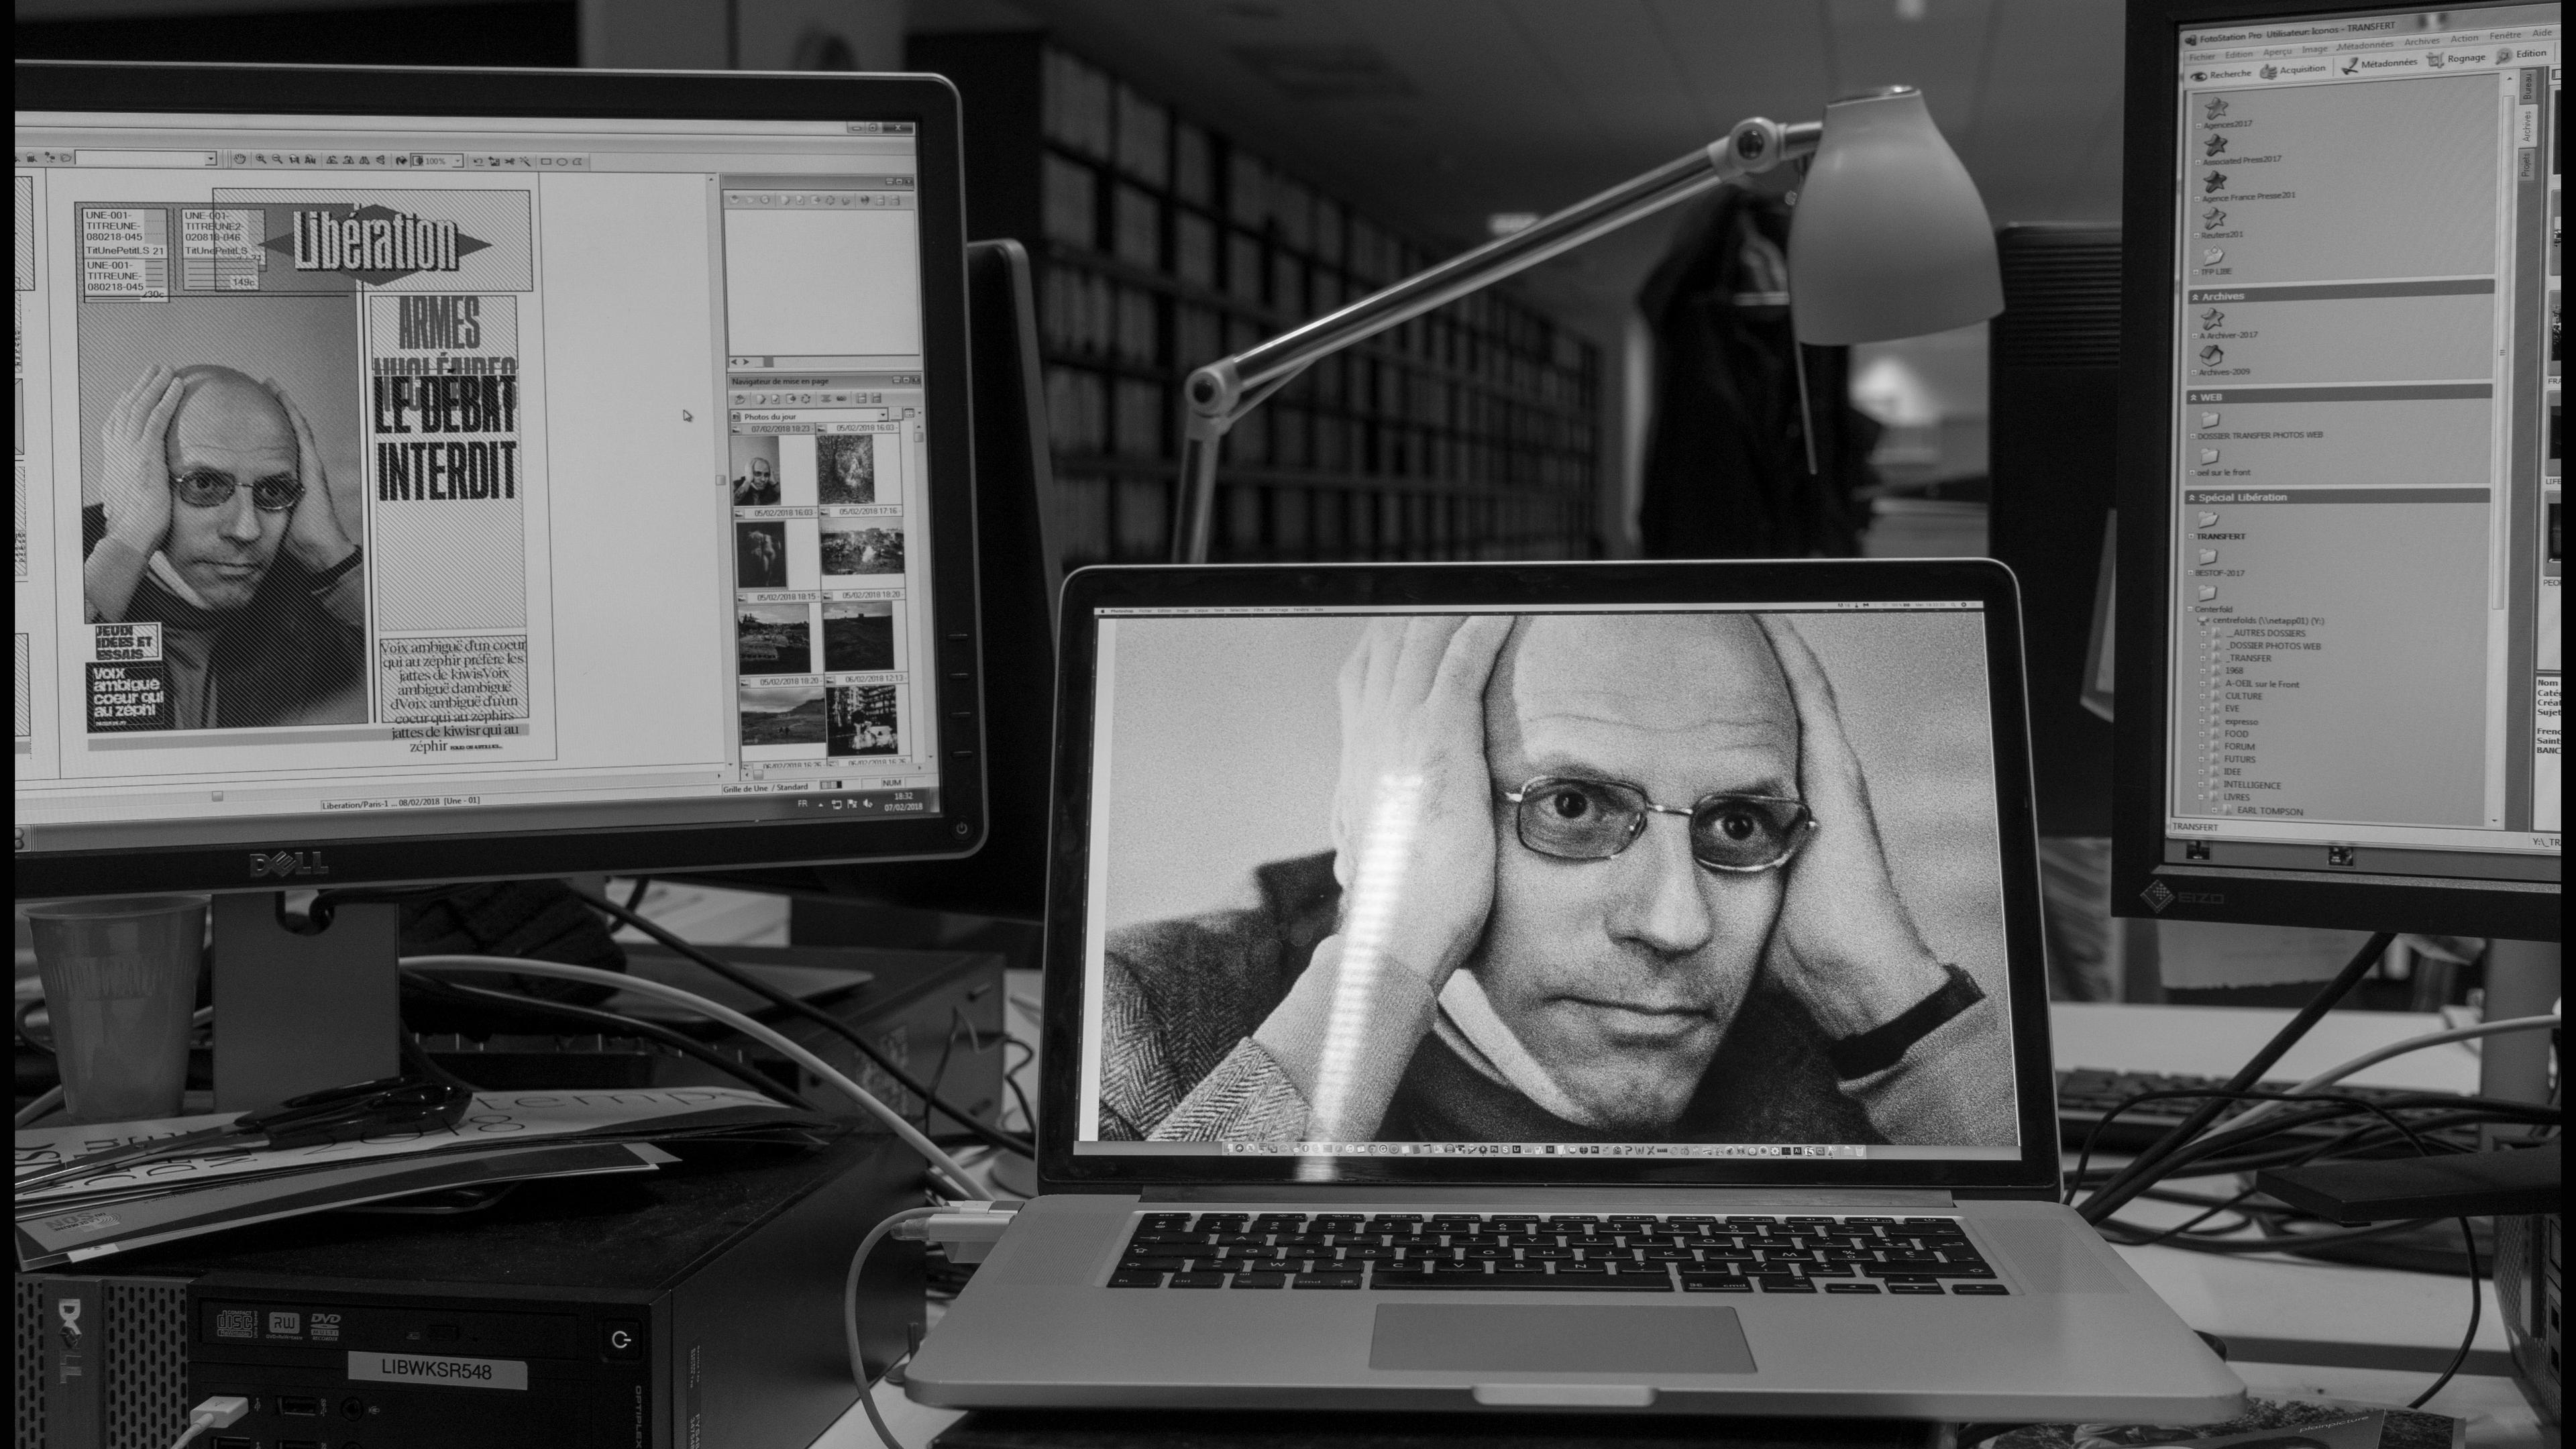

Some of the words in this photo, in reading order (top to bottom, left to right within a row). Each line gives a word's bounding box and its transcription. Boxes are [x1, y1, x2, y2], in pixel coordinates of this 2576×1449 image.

[2200, 34, 2246, 44] FotoStation
[2248, 32, 2262, 40] Pro
[2267, 29, 2310, 39] Utilisateur:
[2312, 26, 2340, 36] Iconos
[2348, 21, 2396, 33] TRANSFERT
[2190, 53, 2216, 62] Fichier
[2225, 50, 2253, 60] Edition
[2263, 48, 2293, 58] Aperçu
[2302, 46, 2328, 54] Image
[2338, 40, 2394, 52] Métadonnées
[2404, 37, 2440, 46] Archives
[2451, 34, 2479, 44] Action
[2489, 31, 2522, 40] Fenêtre
[2532, 28, 2553, 38] Aide
[2210, 69, 2253, 79] Recherche
[2280, 64, 2326, 75] Acquisition
[2361, 58, 2418, 69] Métadonnées
[2448, 54, 2487, 64] Rognage
[2516, 49, 2547, 59] Edition
[2523, 73, 2532, 100] Bureau
[2522, 111, 2532, 142] Archives
[425, 157, 446, 166] 100%
[2521, 152, 2530, 178] Projets
[2202, 195, 2229, 204] Agence
[2231, 194, 2256, 202] France
[86, 211, 132, 220] UNE-001-
[184, 211, 230, 220] UNE-001-
[86, 221, 141, 230] TITREUNE-
[184, 222, 245, 231] TITREUNE2-
[86, 232, 143, 241] 080218-045
[293, 209, 460, 272] Libération
[86, 246, 150, 256] TitUnePetitLS
[152, 247, 164, 256] 21
[184, 246, 248, 256] TitUnePetitLS
[87, 260, 133, 270] UNE-001-
[87, 272, 142, 280] TITREUNE-
[87, 282, 144, 292] 080218-045
[2202, 292, 2245, 302] Archives
[399, 295, 480, 350] ARMES
[732, 377, 771, 388] Navigateur
[773, 378, 782, 386] de
[783, 378, 800, 386] mise
[811, 378, 829, 387] page
[2200, 393, 2222, 402] WEB
[374, 375, 411, 434] LE
[745, 413, 769, 421] Photos
[770, 413, 780, 421] du
[781, 413, 796, 421] jour
[751, 424, 790, 433] 07/02/2018
[837, 423, 875, 432] 05/02/2018
[2273, 431, 2305, 439] PHOTOS
[2306, 431, 2324, 439] WEB
[377, 441, 517, 502] INTERDIT
[2199, 492, 2235, 502] Spécial
[2238, 492, 2288, 502] Libération
[755, 508, 794, 517] 05/02/2018
[839, 508, 878, 516] 05/02/2018
[2197, 533, 2247, 541] TRANSFERT
[757, 592, 796, 602] 05/02/2018
[842, 591, 881, 600] 05/02/2018
[2195, 606, 2233, 614] Centerfold
[2213, 616, 2257, 625] centrefolds
[96, 625, 133, 637] JEUDI
[2267, 629, 2306, 638] DOSSIERS
[137, 636, 154, 648] ET
[380, 642, 409, 654] Voix
[411, 639, 464, 655] ambiguë
[464, 639, 490, 652] d'un
[493, 641, 527, 652] coeur
[2265, 642, 2302, 650] PHOTOS
[2303, 643, 2322, 651] WEB
[97, 649, 144, 661] ESSAIS
[383, 656, 402, 670] qui
[405, 658, 421, 667] au
[423, 654, 461, 669] zéphir
[464, 653, 504, 668] préfère
[507, 652, 525, 664] les
[400, 669, 431, 684] jattes
[433, 668, 448, 680] de
[2225, 667, 2244, 675] 1968
[760, 677, 800, 686] 05/02/2018
[845, 675, 884, 684] 06/02/2018
[2225, 680, 2253, 688] A-OEIL
[2278, 681, 2300, 689] Front
[2538, 679, 2559, 687] Nom
[398, 682, 449, 696] ambiguë
[94, 692, 140, 705] coeur
[141, 690, 164, 705] qui
[2225, 692, 2263, 701] CULTURE
[429, 696, 482, 710] ambiguë
[94, 705, 113, 718] au
[395, 714, 430, 725] coeur
[431, 712, 451, 726] qui
[453, 713, 469, 723] au
[2225, 718, 2259, 727] expresso
[392, 727, 424, 741] jattes
[425, 726, 441, 738] de
[443, 724, 482, 737] kiwisr
[482, 725, 502, 739] qui
[504, 725, 519, 735] au
[2224, 730, 2249, 738] FOOD
[410, 739, 449, 755] zéphir
[2224, 743, 2256, 751] FORUM
[2224, 755, 2256, 764] FUTURS
[2224, 767, 2242, 776] IDEE
[723, 784, 743, 794] Grille
[743, 784, 753, 793] de
[754, 784, 769, 793] Une
[777, 781, 809, 792] Standard
[882, 779, 902, 788] NUM
[2224, 780, 2282, 790] INTELLIGENCE
[895, 792, 913, 800] 18:32
[2224, 793, 2251, 802] LIVRES
[322, 799, 388, 810] Liberation/Paris-1
[398, 798, 440, 806] 08/02/2018
[797, 800, 808, 808] FR
[884, 802, 924, 812] 07/02/2018
[2237, 806, 2257, 815] EARL
[2261, 806, 2304, 816] TOMPSON
[2173, 822, 2218, 832] TRANSFERT
[250, 850, 330, 878] DELL
[2179, 892, 2225, 905] EIZO
[311, 1313, 342, 1324] DVD
[381, 1358, 492, 1381] LIBWKSR548
[635, 1385, 643, 1449] OPTIPLEX
[2299, 1415, 2369, 1434] plainpicture
